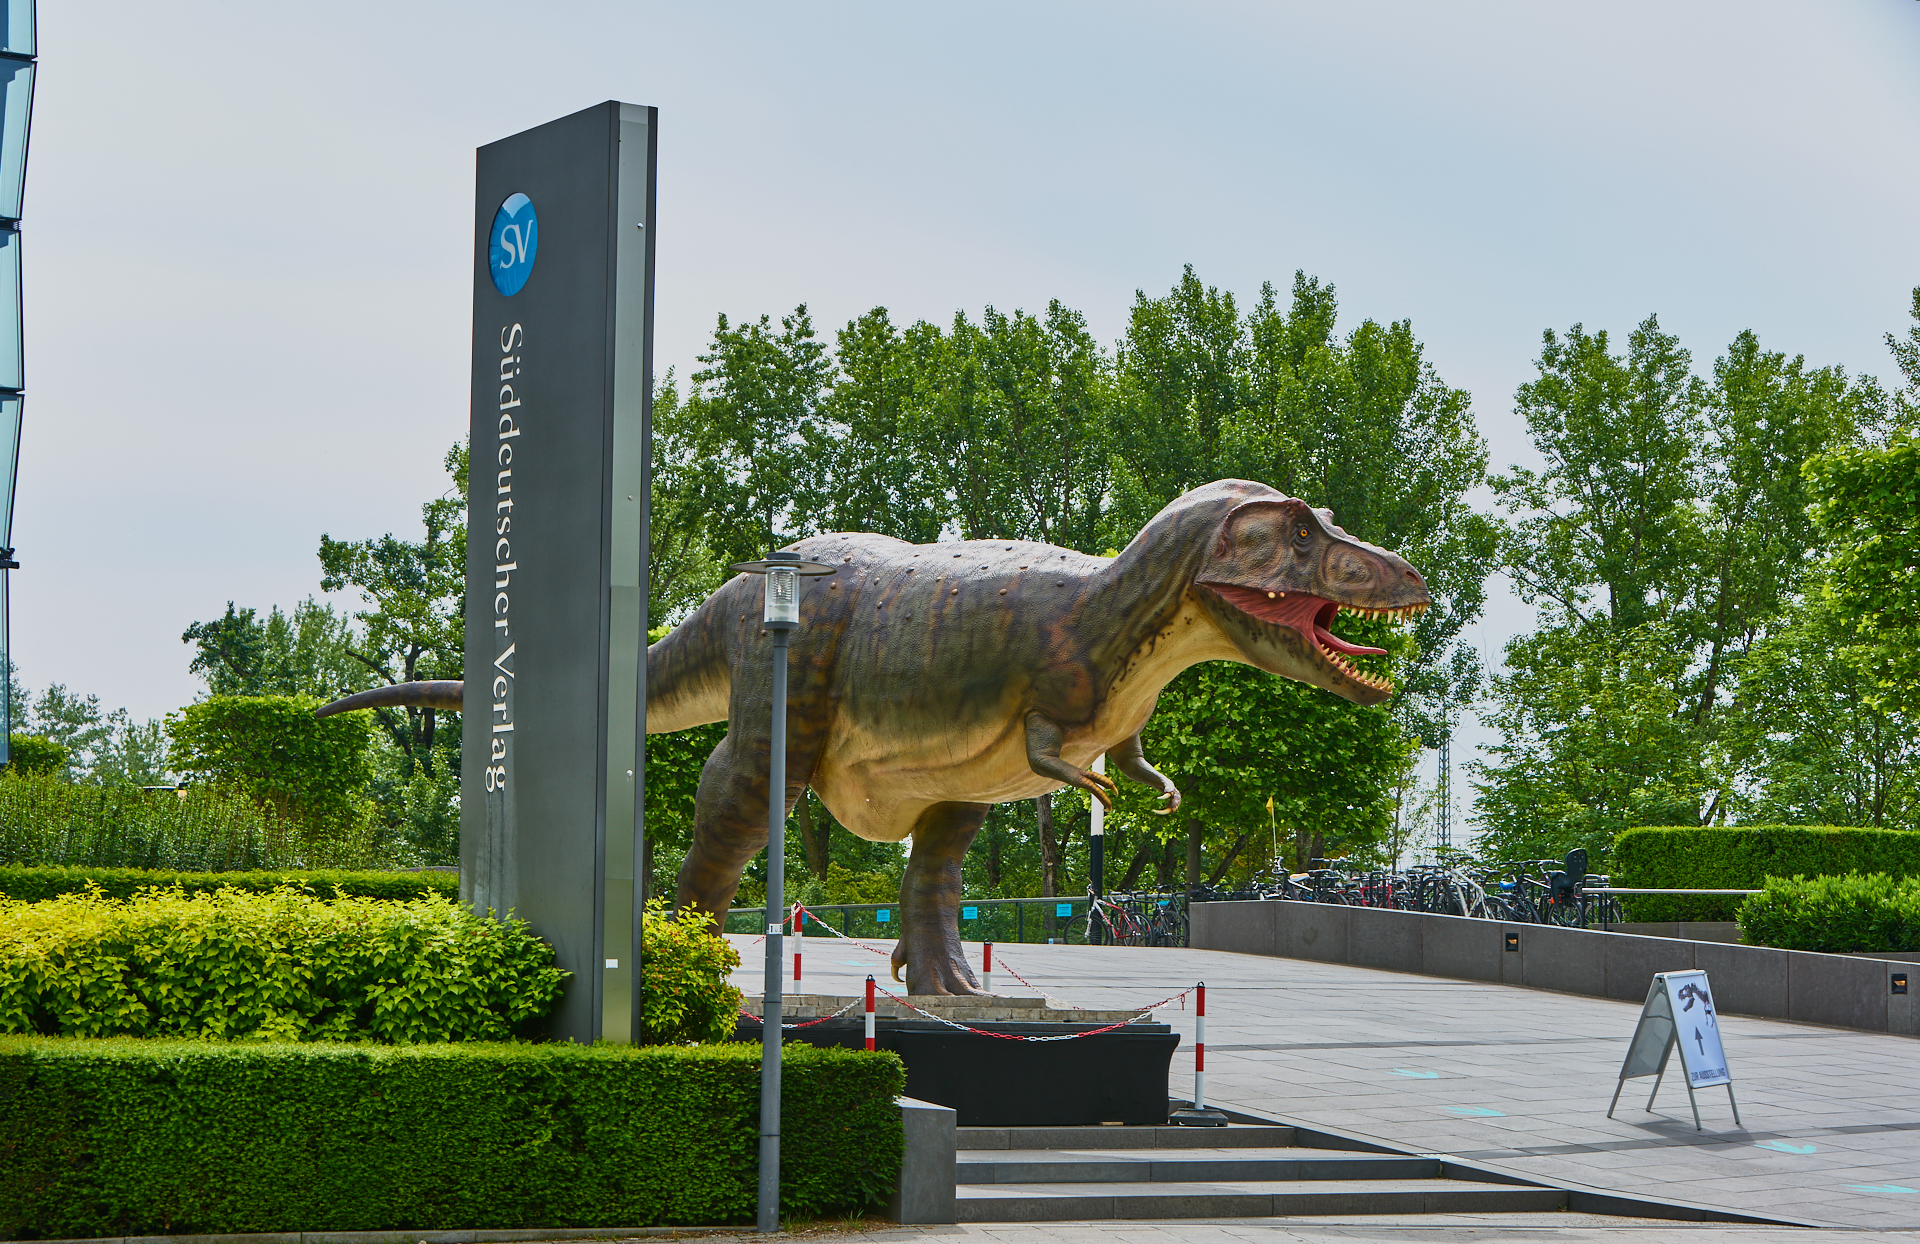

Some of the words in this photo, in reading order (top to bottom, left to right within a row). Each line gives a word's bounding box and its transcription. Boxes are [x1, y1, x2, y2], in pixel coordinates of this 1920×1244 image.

[500, 219, 534, 269] SV
[494, 322, 523, 637] Süddeutscher
[485, 642, 516, 793] Verlag
